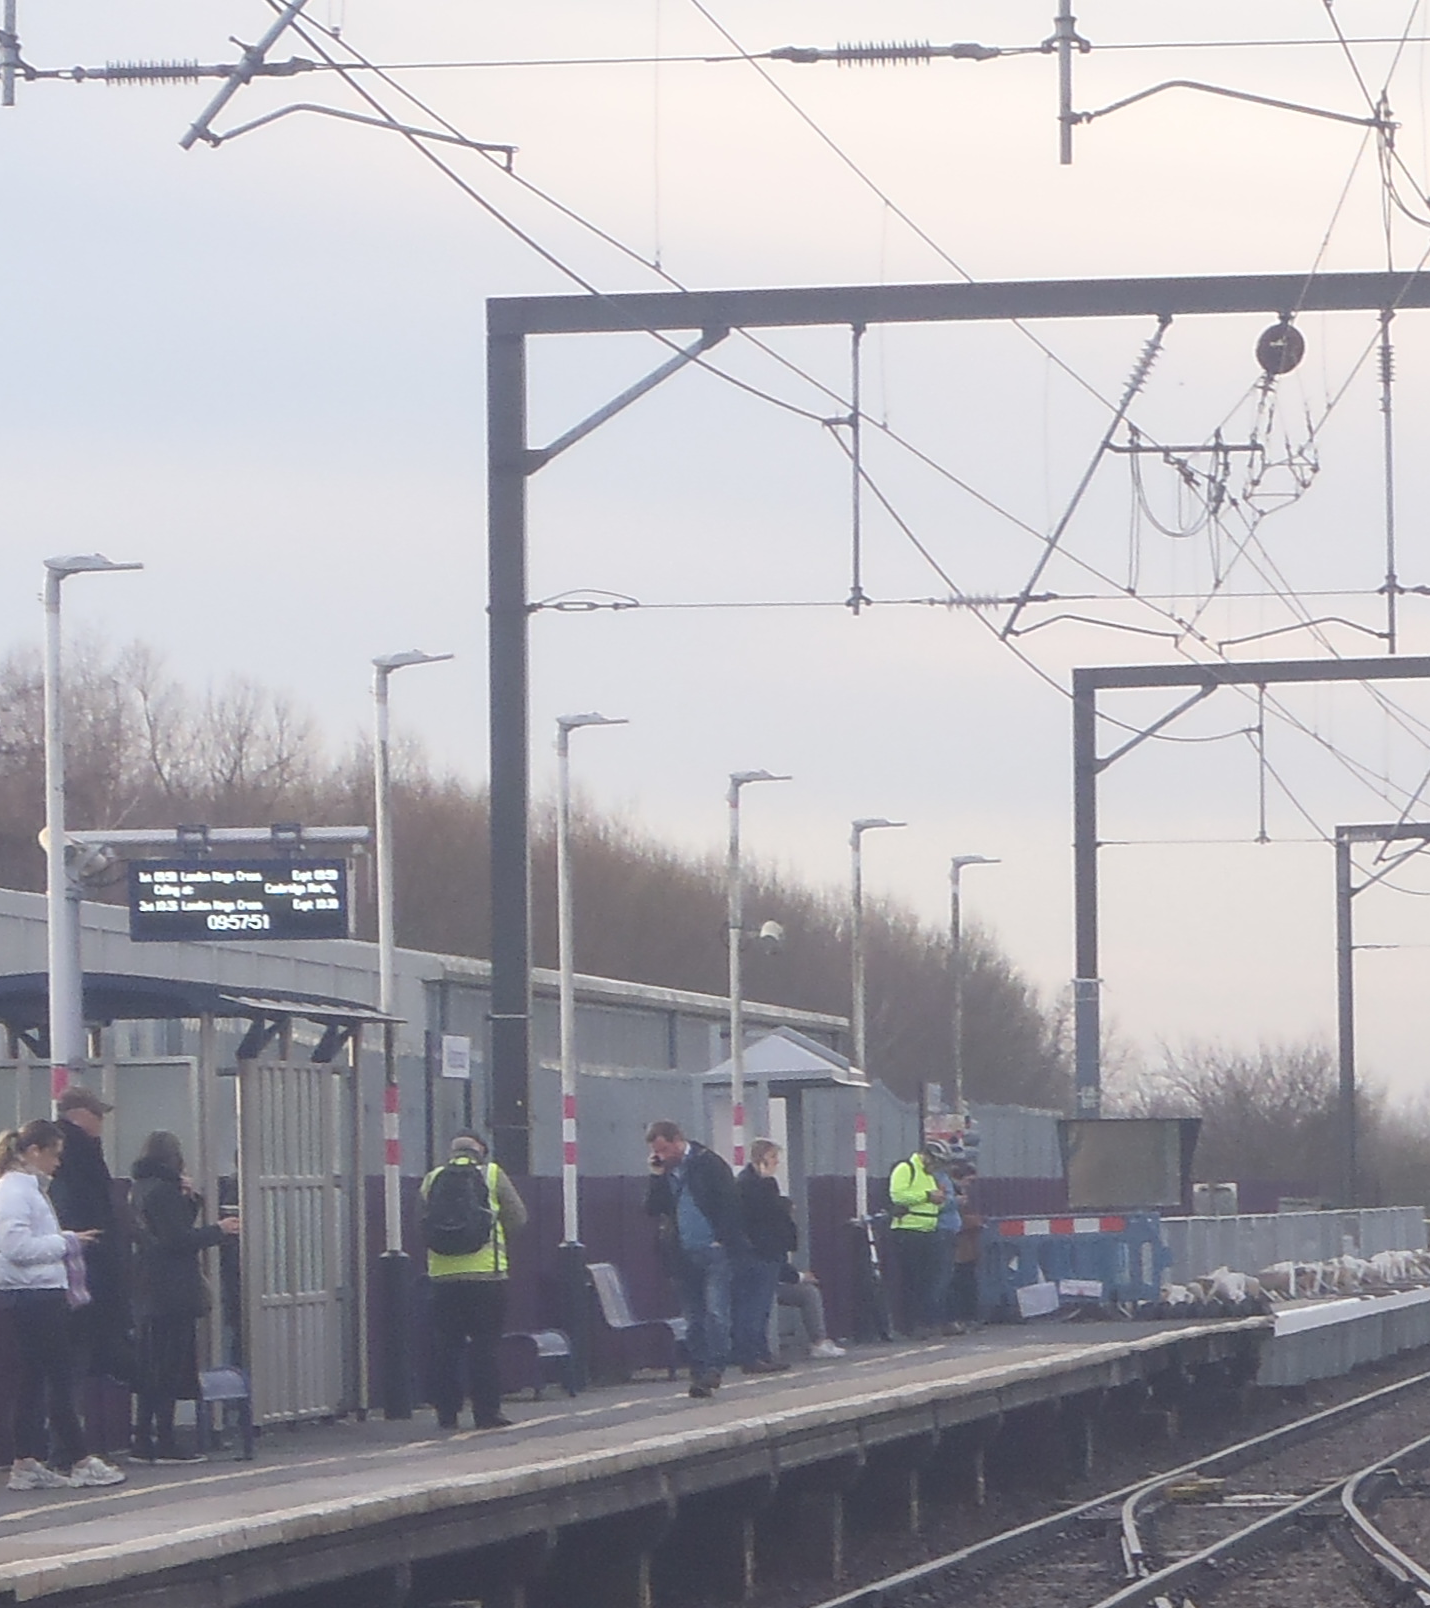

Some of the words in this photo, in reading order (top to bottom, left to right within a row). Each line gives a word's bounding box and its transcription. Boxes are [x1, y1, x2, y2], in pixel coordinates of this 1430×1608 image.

[180, 871, 211, 882] London
[211, 871, 235, 884] Kings
[236, 870, 262, 882] Cross
[153, 883, 181, 897] Calling
[264, 882, 306, 896] Cambridge
[181, 900, 212, 911] London
[213, 900, 236, 913] Kings
[237, 899, 263, 911] Cross
